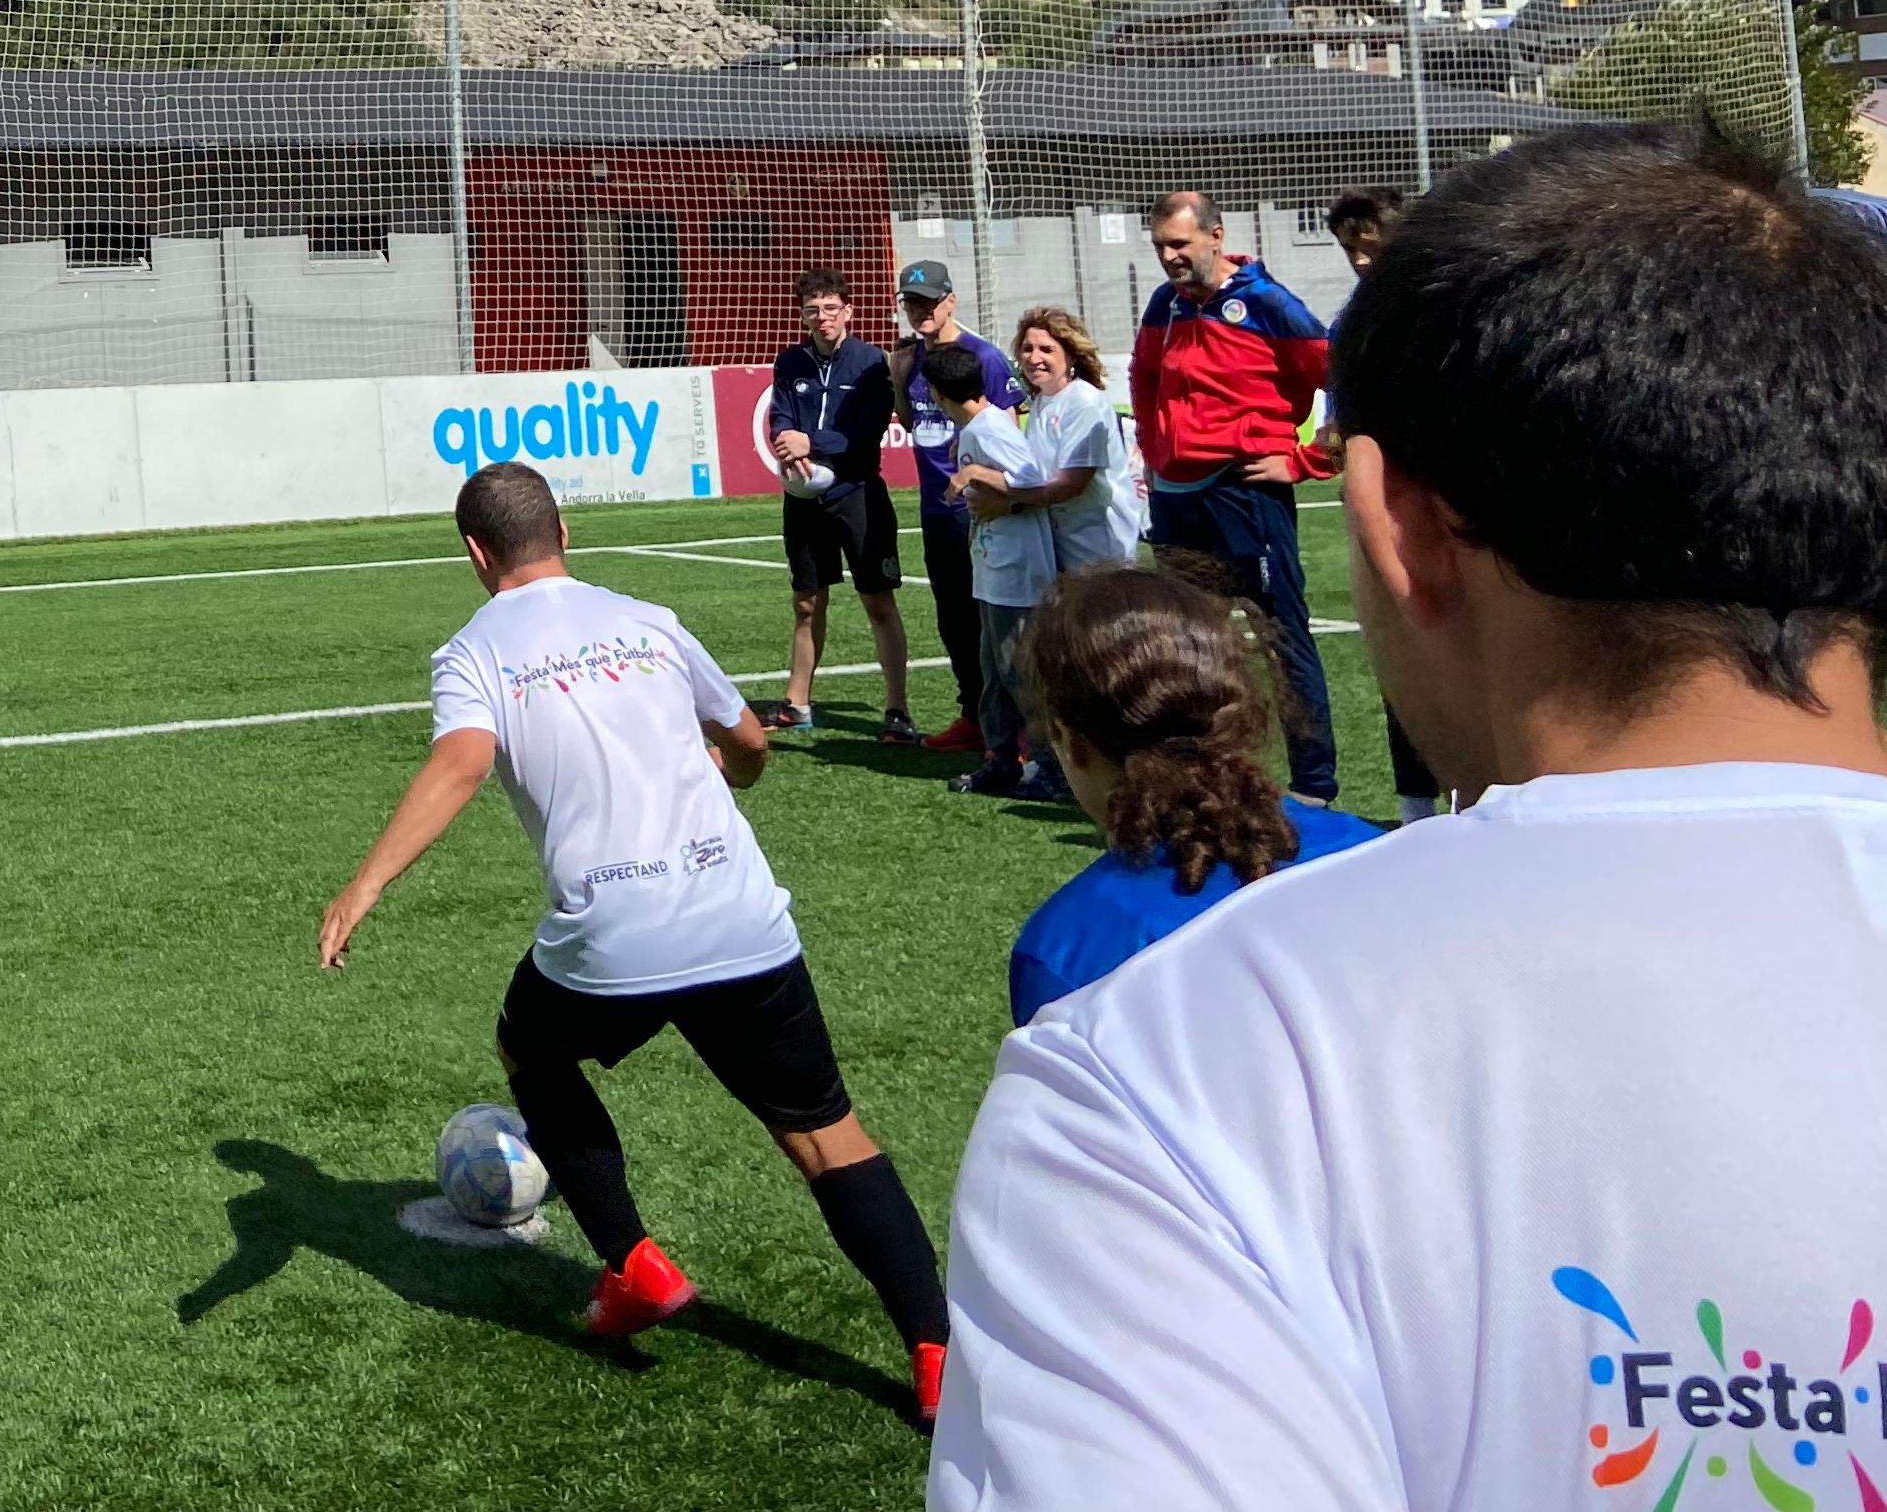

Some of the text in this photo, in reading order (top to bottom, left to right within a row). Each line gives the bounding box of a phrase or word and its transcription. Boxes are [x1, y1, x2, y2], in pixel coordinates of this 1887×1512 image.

[433, 381, 659, 479] quality
[690, 375, 706, 437] SERVEIS
[561, 489, 646, 505] Andorra la Vella
[515, 666, 549, 687] Festa
[586, 653, 611, 669] que
[613, 646, 654, 661] Futbol
[585, 861, 668, 885] RESPECTAND
[1622, 1351, 1847, 1435] Festa
